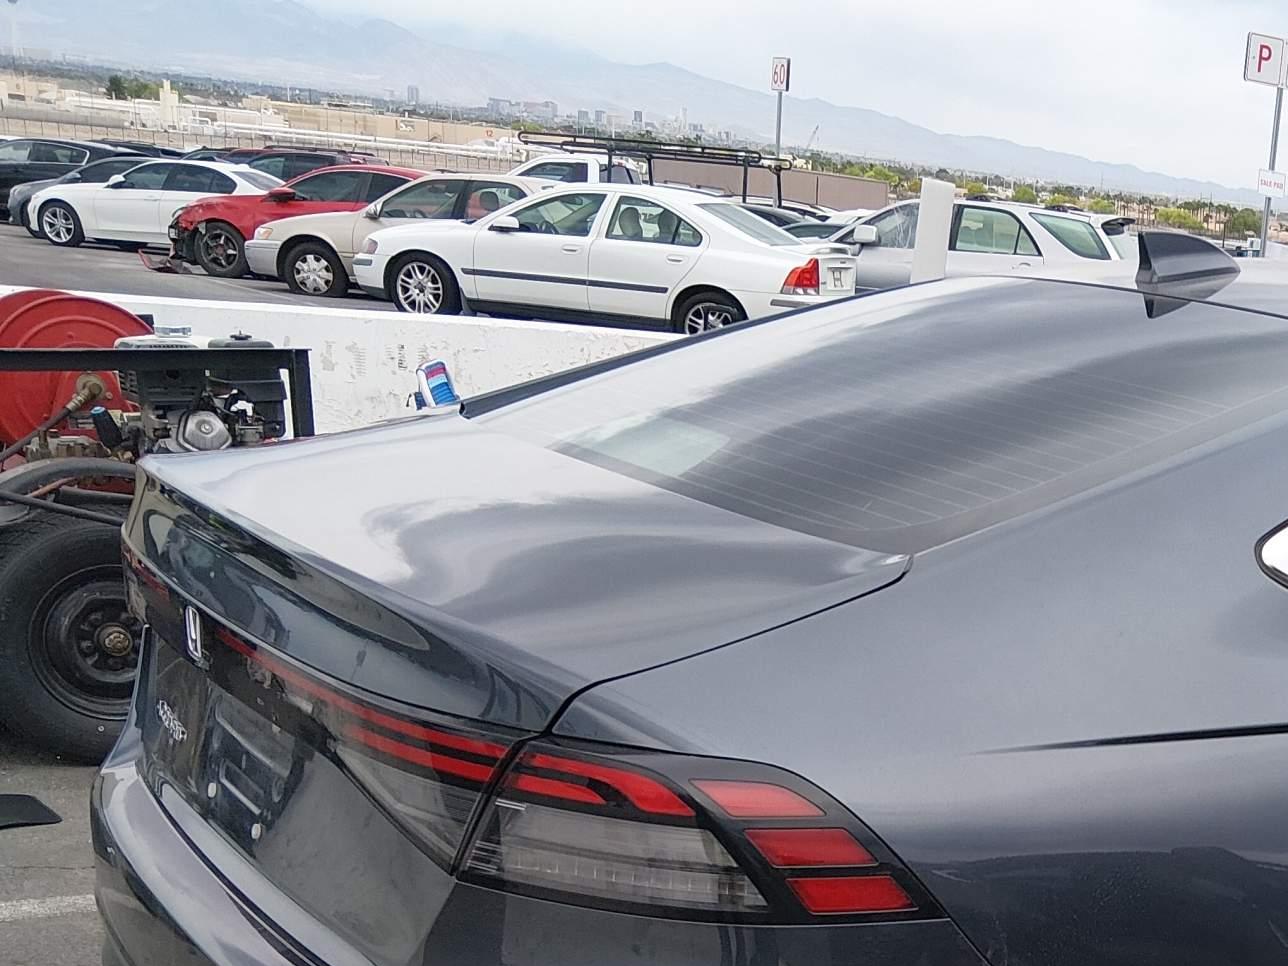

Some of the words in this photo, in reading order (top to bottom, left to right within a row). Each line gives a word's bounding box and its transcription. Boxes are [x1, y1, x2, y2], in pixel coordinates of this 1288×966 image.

[1257, 44, 1272, 73] P
[773, 63, 786, 85] 60
[485, 130, 494, 138] 12
